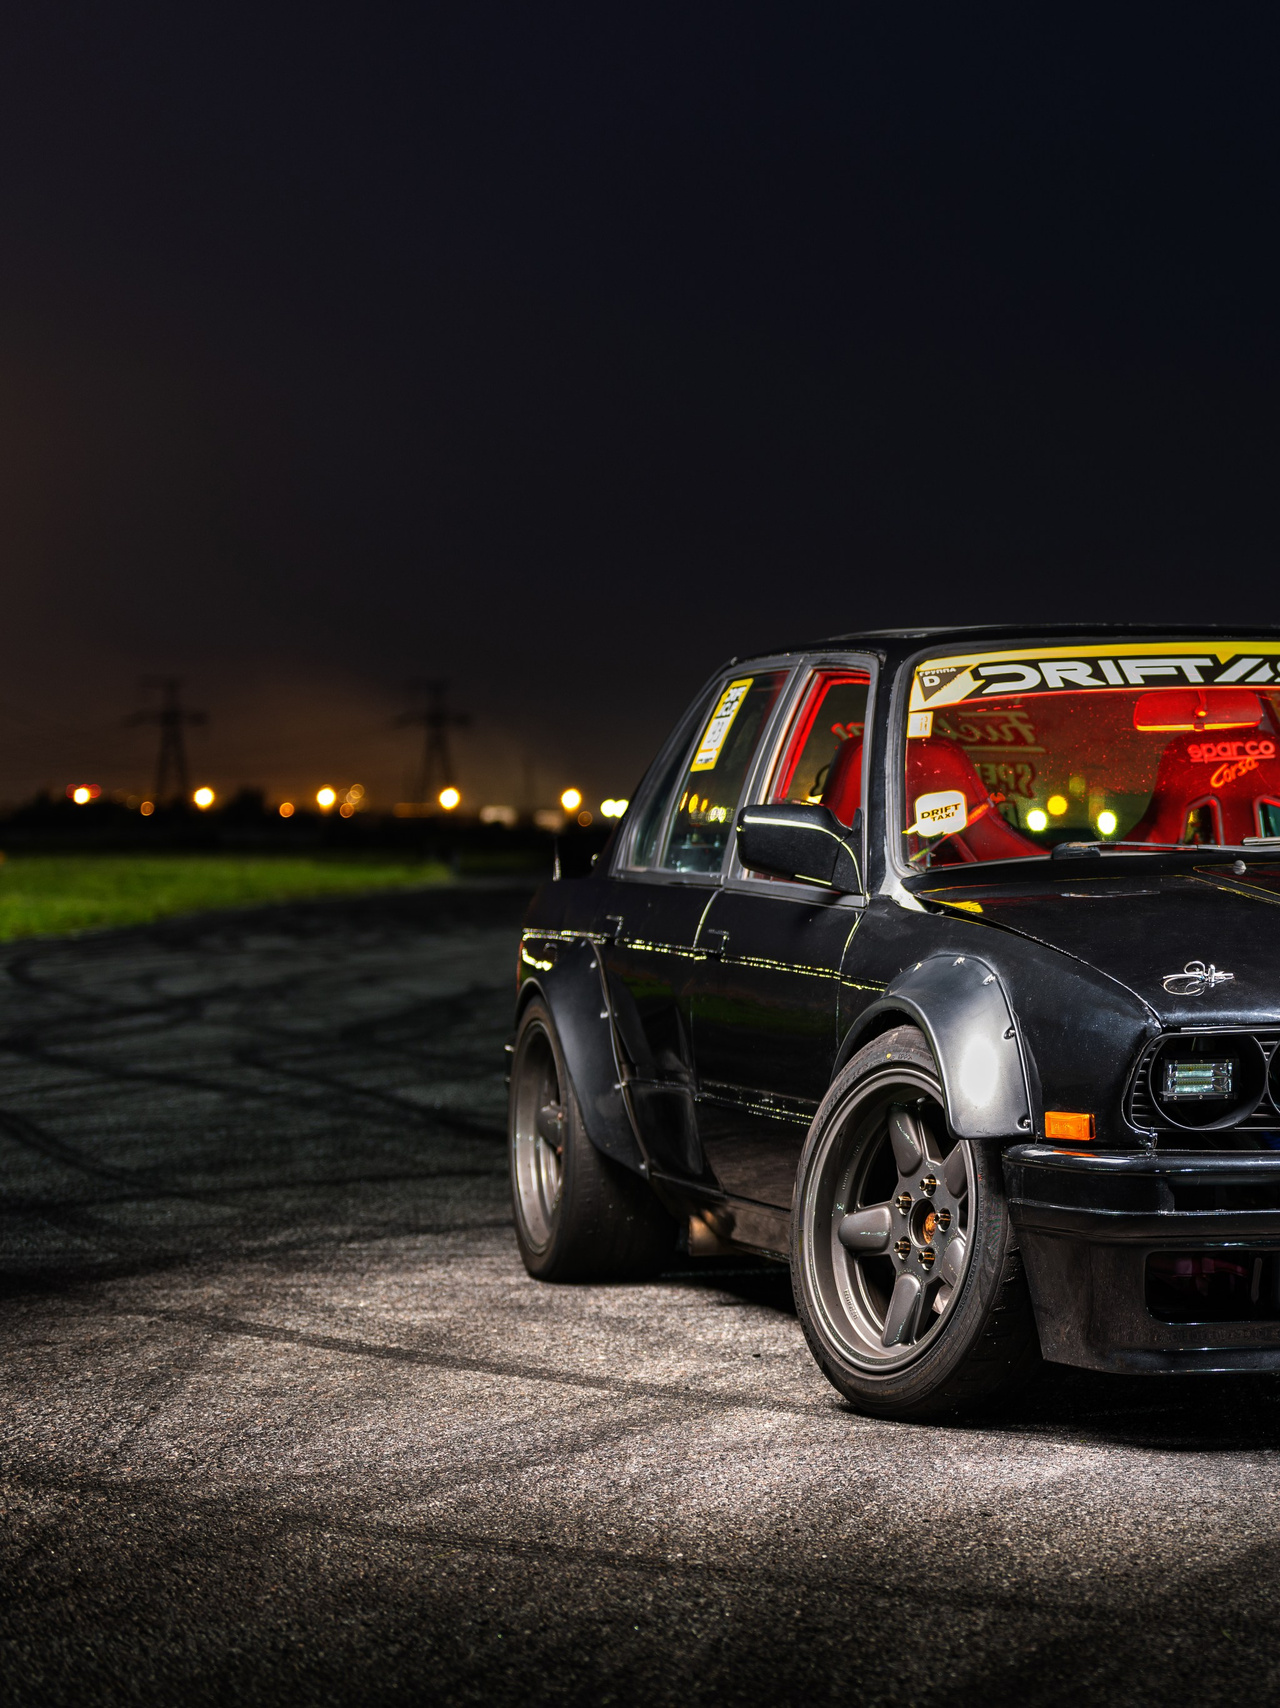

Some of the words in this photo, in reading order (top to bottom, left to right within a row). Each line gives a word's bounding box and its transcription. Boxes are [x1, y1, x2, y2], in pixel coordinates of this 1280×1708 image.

[919, 667, 957, 677] ГРУППА
[977, 657, 1216, 694] DRIFT
[922, 675, 941, 688] D
[1187, 740, 1276, 763] sparco
[1210, 757, 1260, 788] Corsa
[921, 802, 962, 819] DRIFT
[931, 811, 955, 822] TAXI
